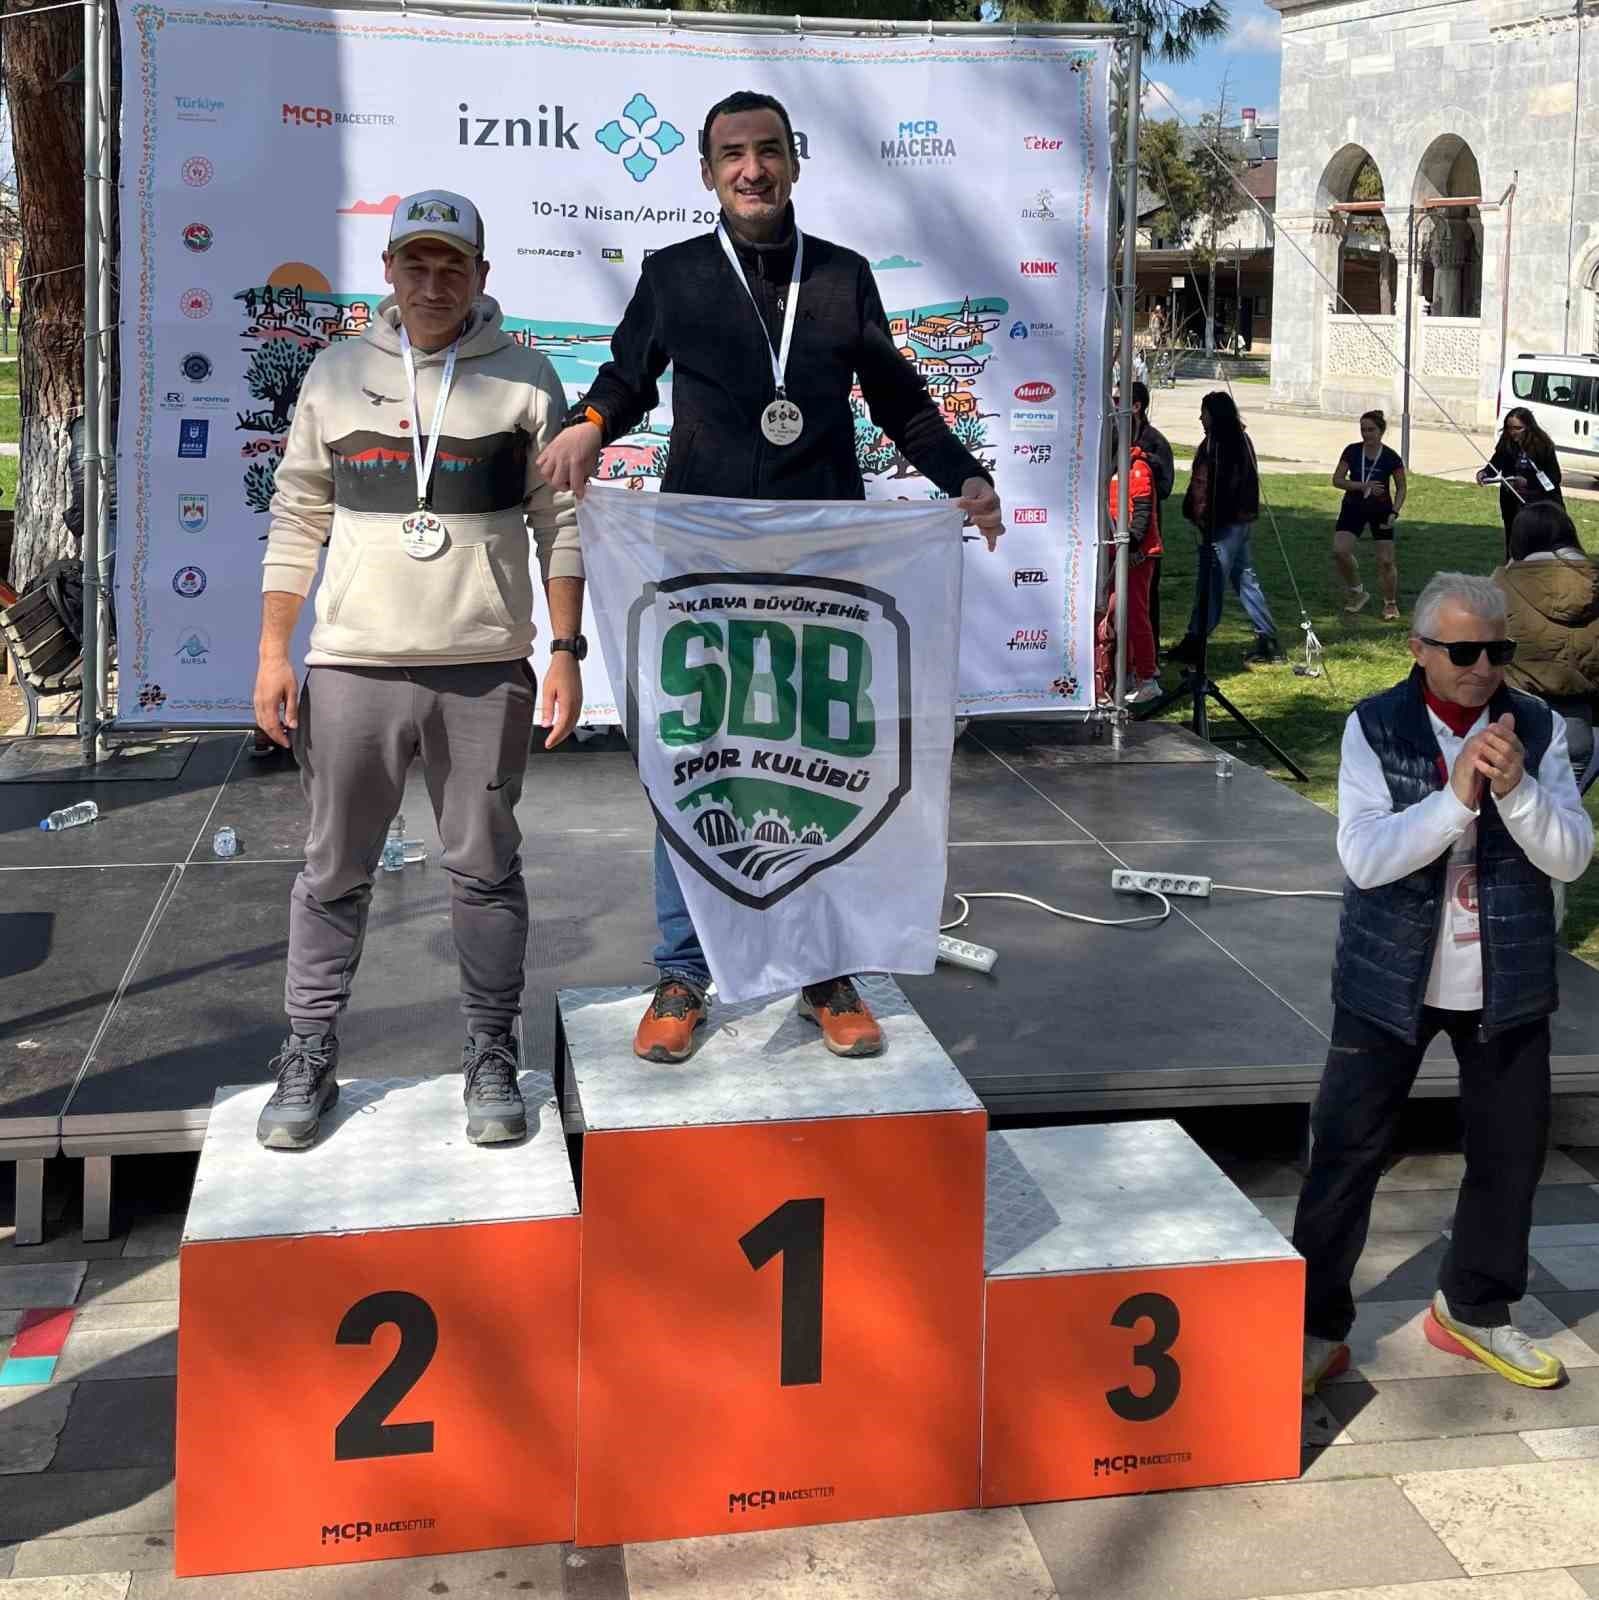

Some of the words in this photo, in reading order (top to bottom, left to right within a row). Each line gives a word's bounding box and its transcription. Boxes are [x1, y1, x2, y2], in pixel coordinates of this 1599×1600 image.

[335, 112, 395, 126] RACESETTER
[458, 103, 579, 150] iznik
[880, 138, 957, 159] MACERA
[531, 201, 578, 218] 10-12
[584, 205, 686, 224] Nisan/April
[1019, 261, 1059, 274] KINIK
[1017, 385, 1051, 398] Mutlu
[1014, 411, 1054, 420] aroma
[1013, 444, 1052, 455] POWER
[1028, 454, 1051, 465] APP
[1014, 571, 1048, 588] PETZL
[753, 594, 870, 623] BÜYÜKŞEHİR
[1015, 630, 1048, 642] PLUS
[659, 618, 876, 759] SBB
[673, 748, 741, 787] SPOR
[751, 749, 871, 793] KULÜBÜ
[737, 1197, 825, 1387] 1
[1104, 1291, 1182, 1423] 3
[334, 1289, 439, 1462] 2
[1139, 1452, 1193, 1467] RACESETTER
[778, 1485, 835, 1501] RACESETTER
[374, 1518, 437, 1535] RACESETTER
